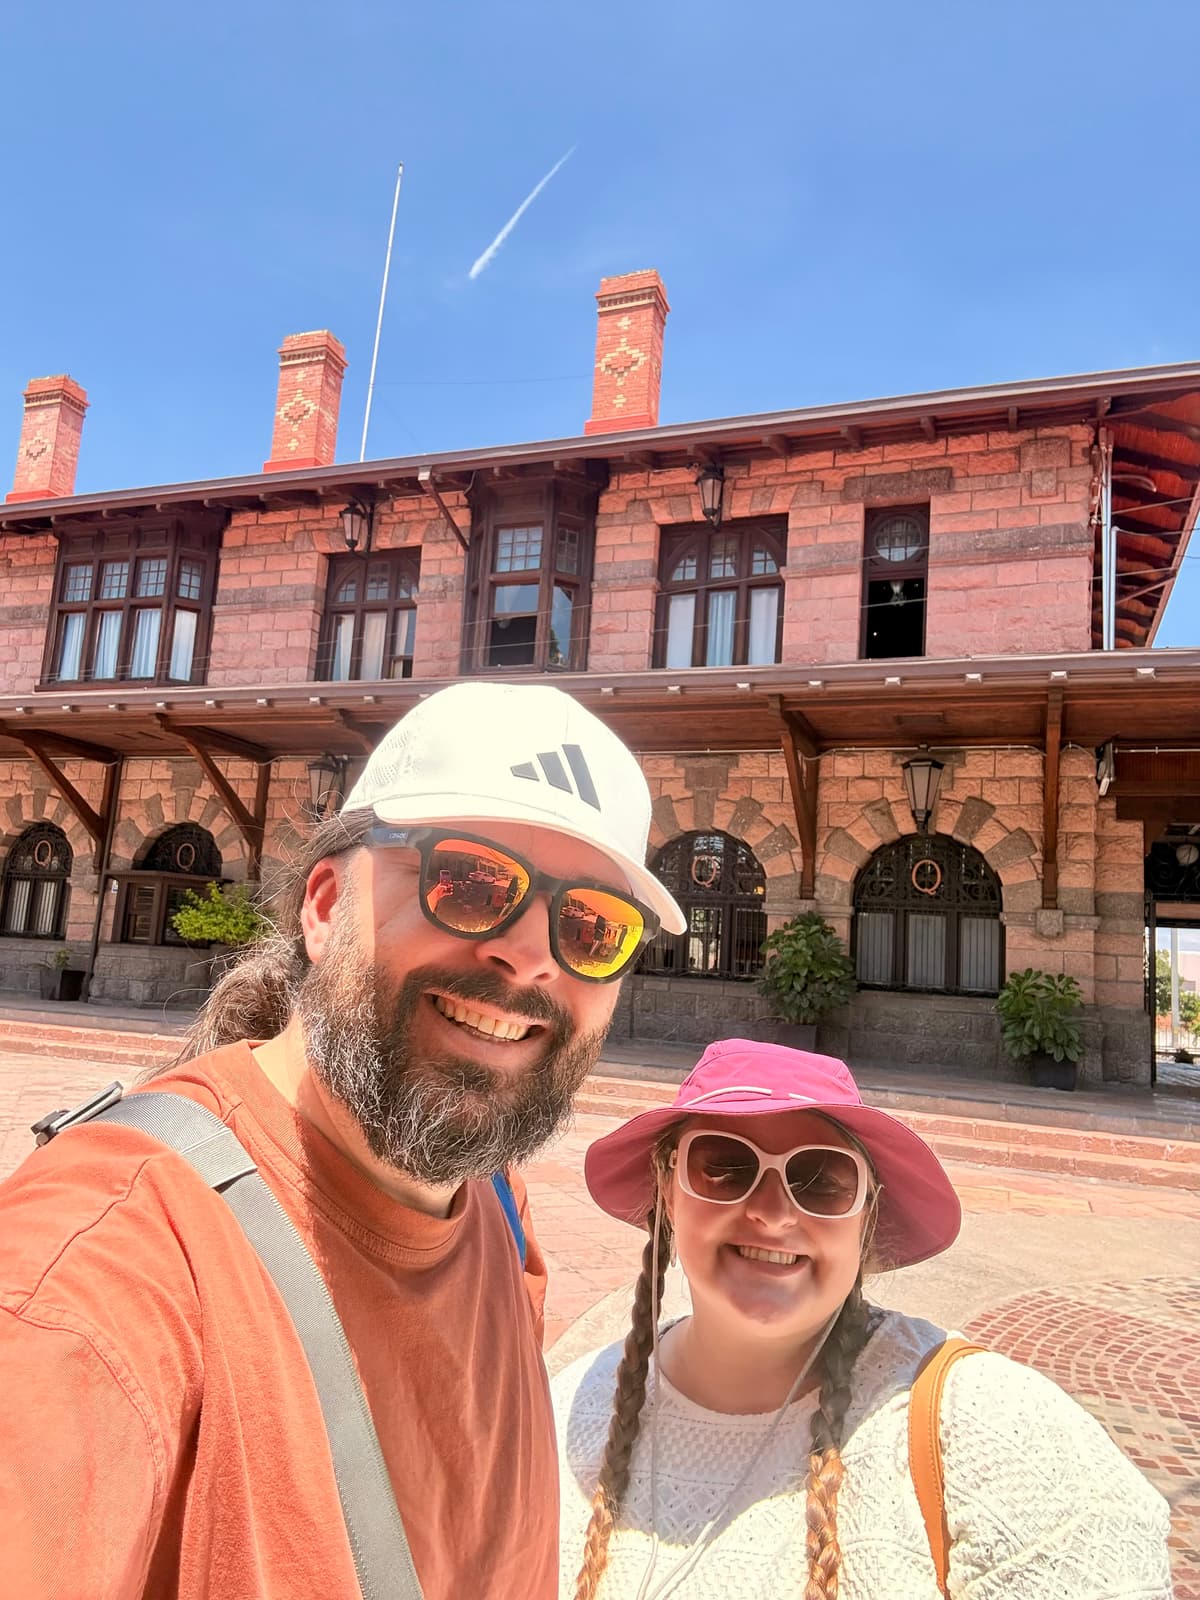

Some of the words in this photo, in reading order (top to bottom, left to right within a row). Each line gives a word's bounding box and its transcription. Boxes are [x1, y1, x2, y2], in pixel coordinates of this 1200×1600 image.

[35, 840, 52, 867] Q
[177, 843, 195, 871] Q
[691, 855, 716, 887] Q
[912, 859, 942, 895] Q
